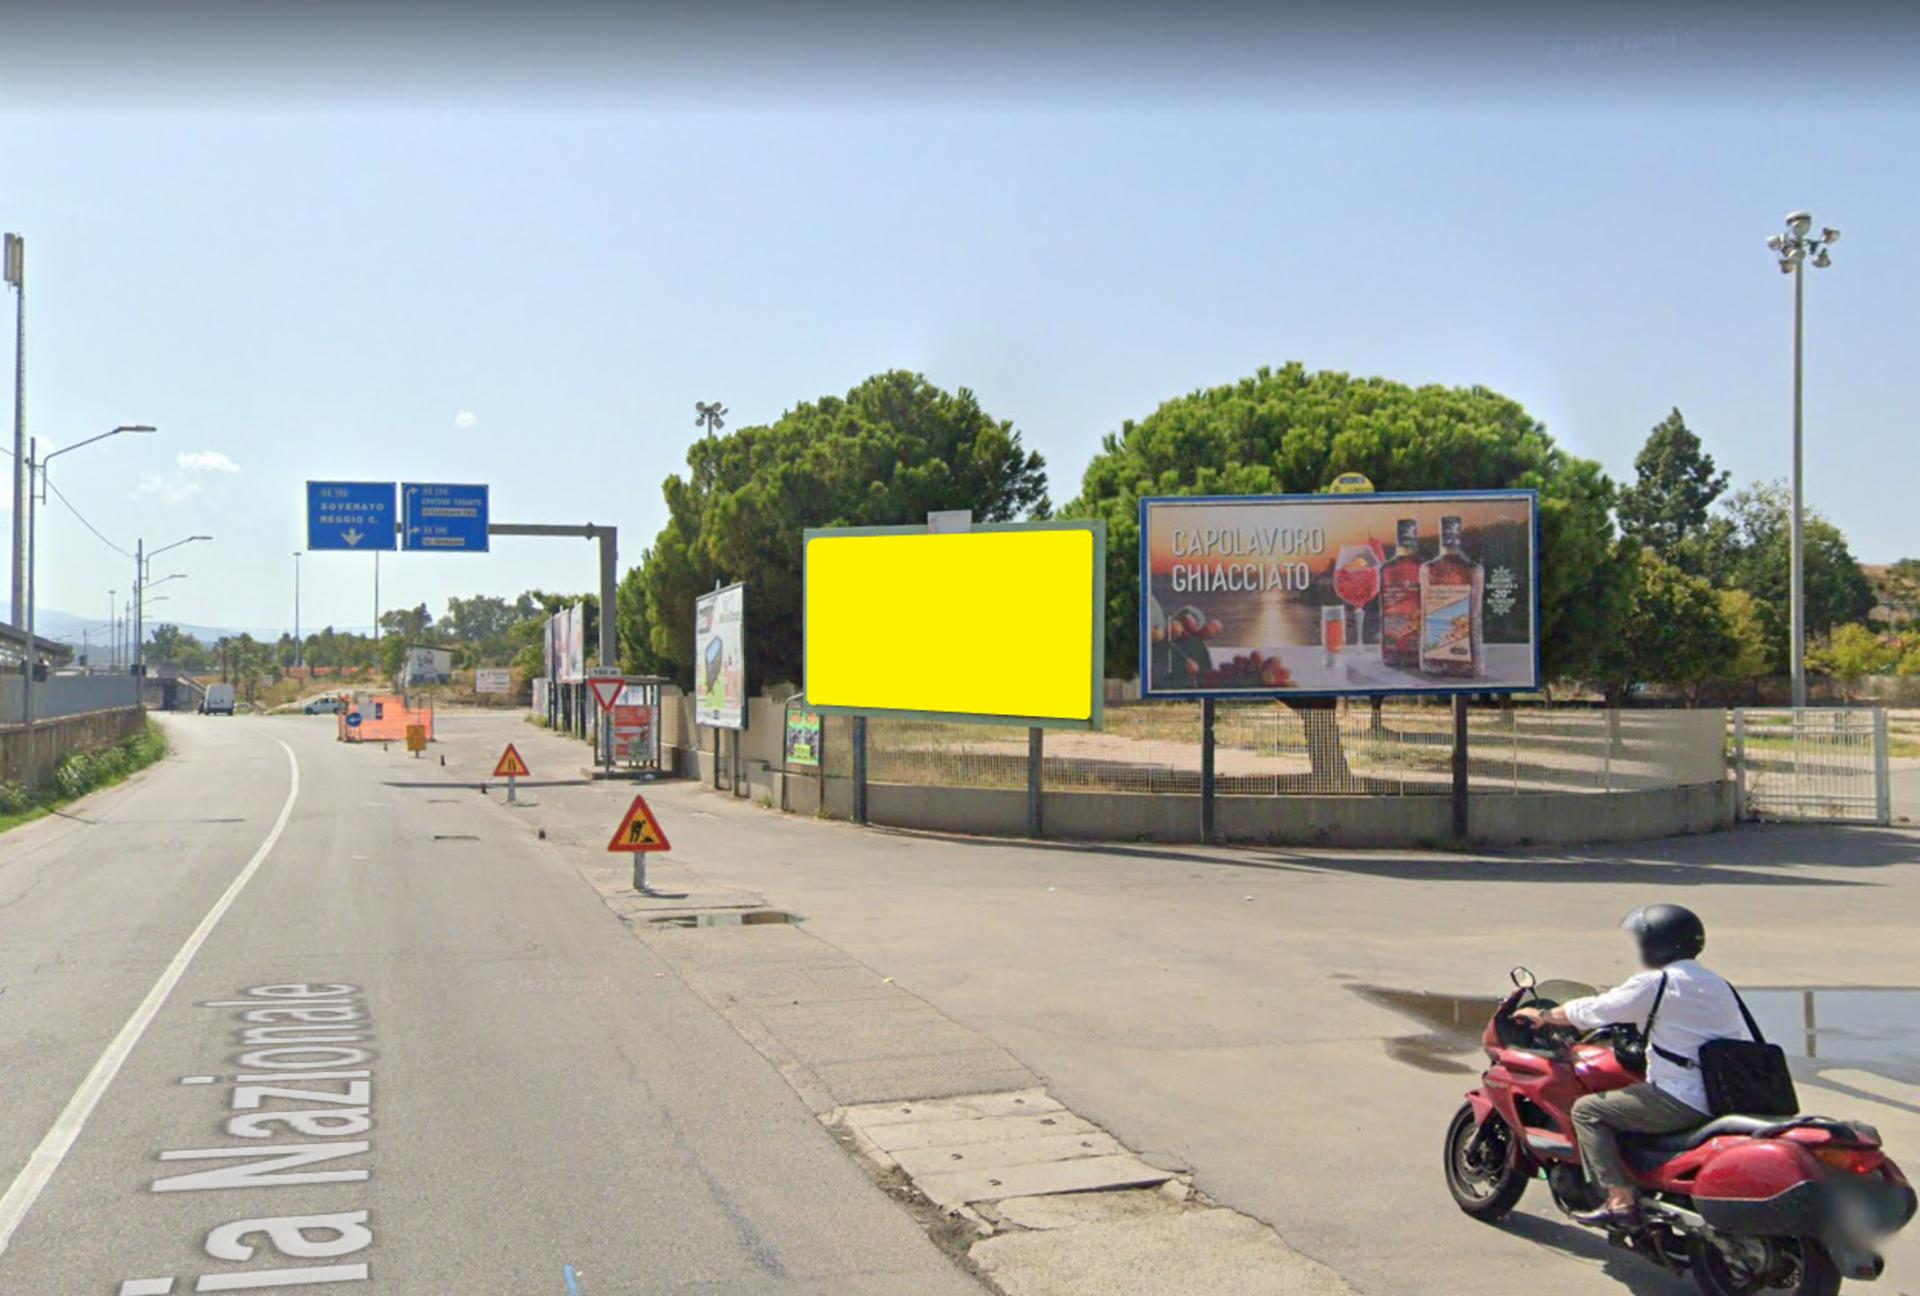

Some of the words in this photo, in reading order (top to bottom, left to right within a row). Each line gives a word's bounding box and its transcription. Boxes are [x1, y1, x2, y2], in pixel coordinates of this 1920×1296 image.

[320, 502, 385, 512] SOVERATO
[320, 515, 364, 524] REGGIO
[1172, 527, 1326, 556] CAPOLAVORO
[1172, 563, 1310, 592] GHIACCIATO
